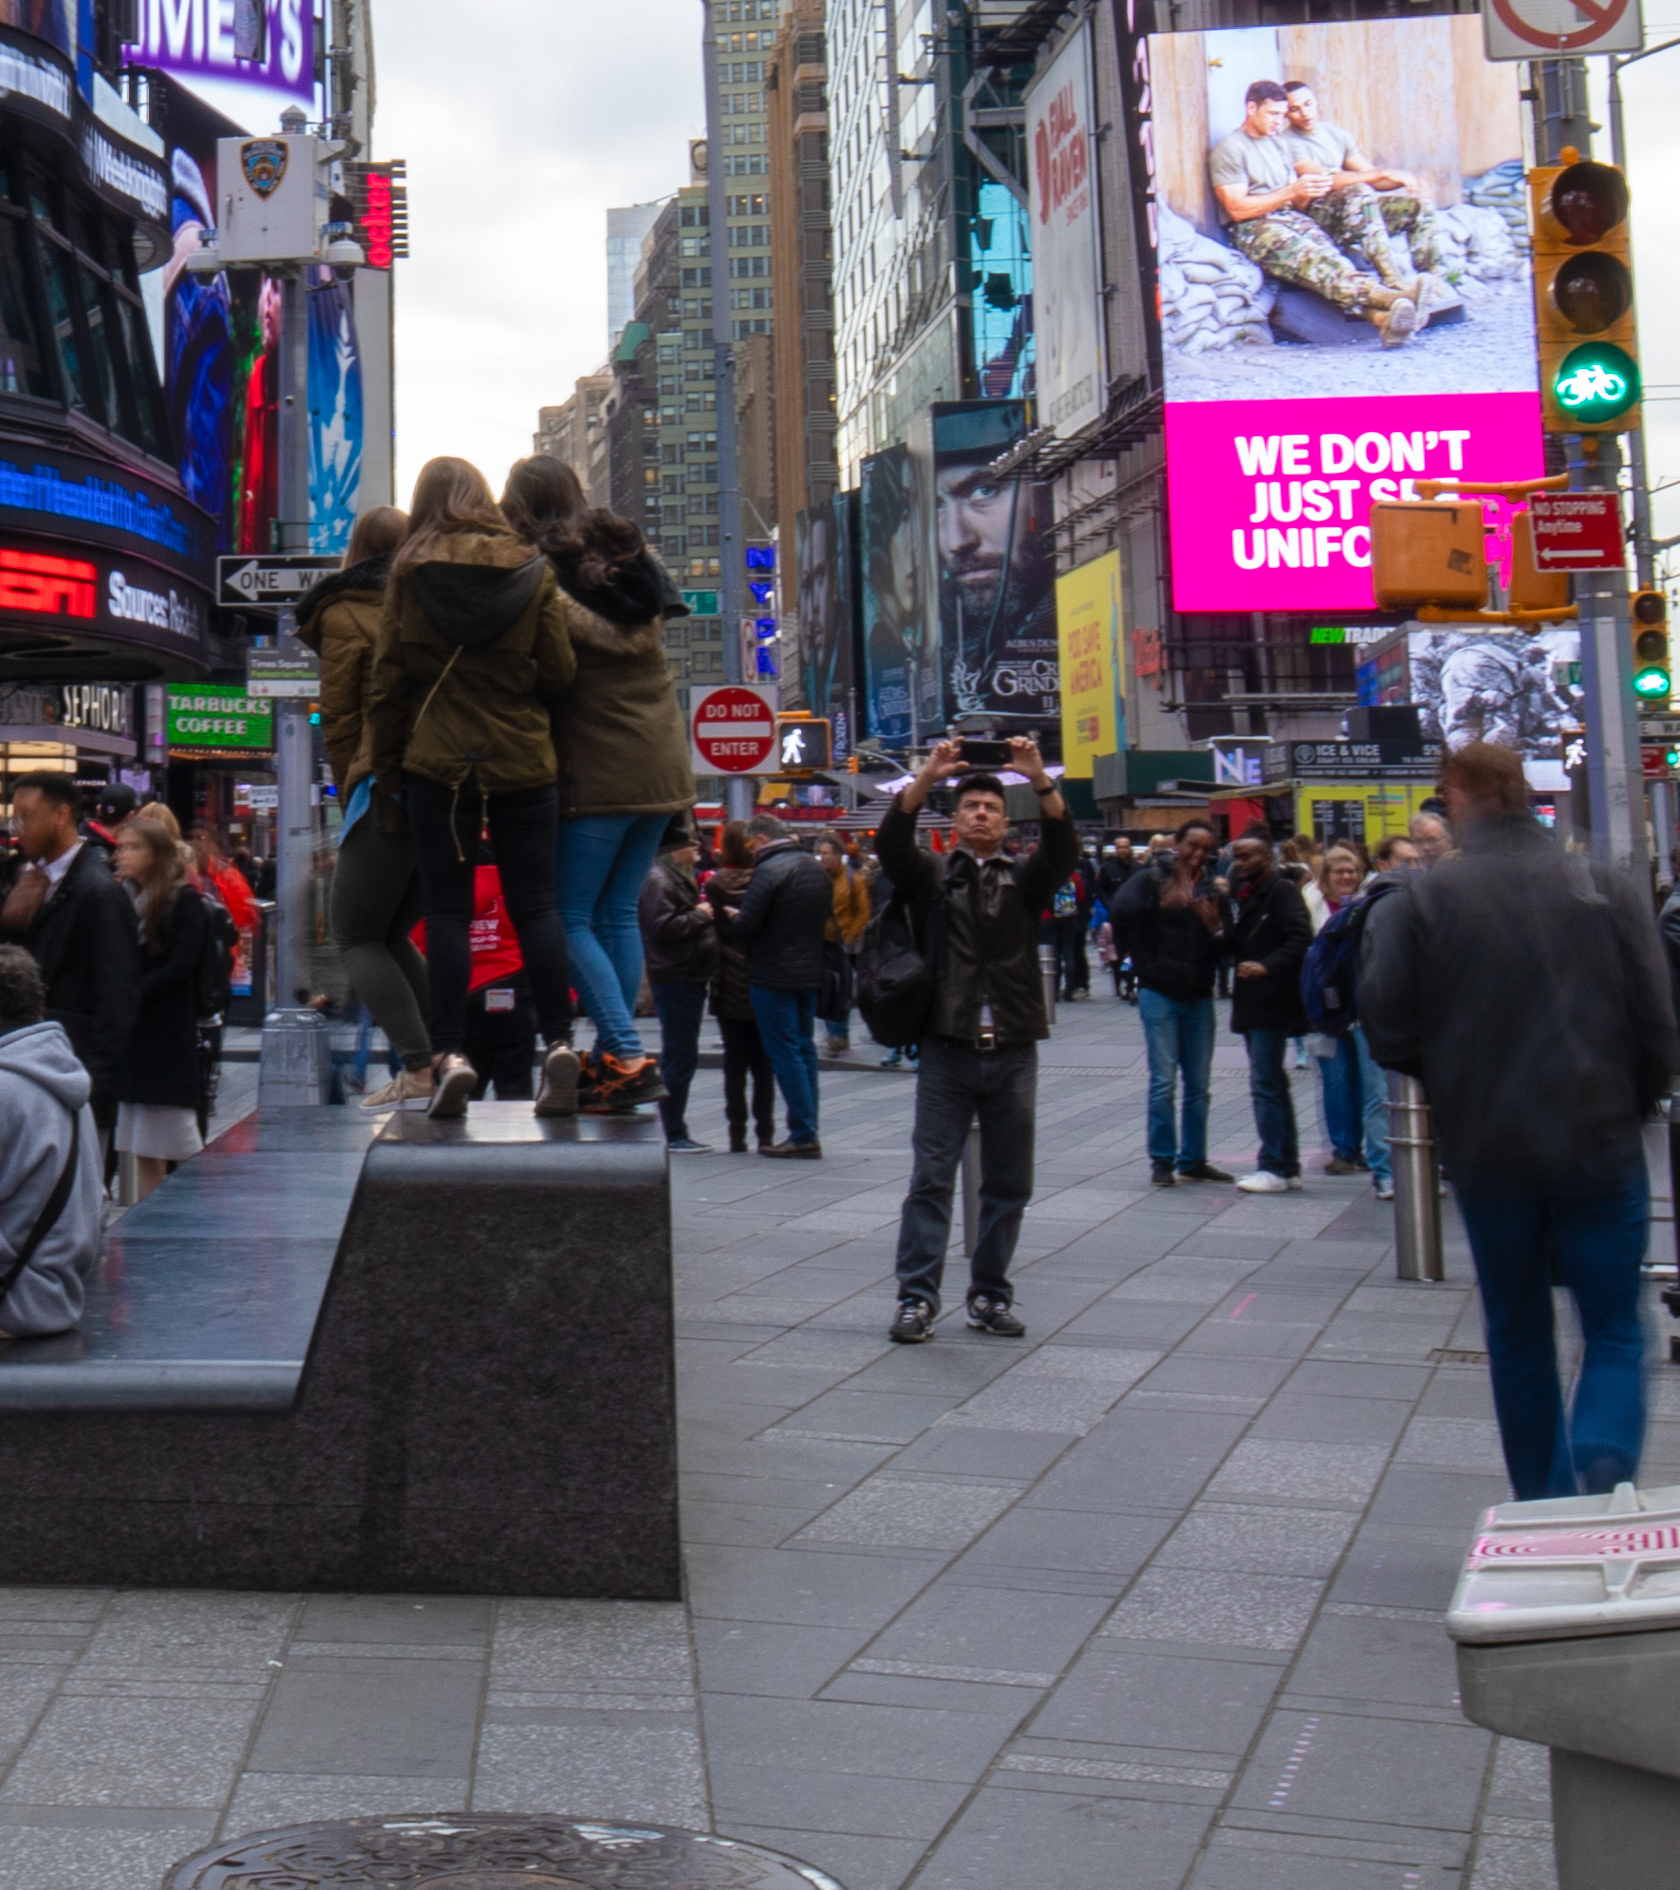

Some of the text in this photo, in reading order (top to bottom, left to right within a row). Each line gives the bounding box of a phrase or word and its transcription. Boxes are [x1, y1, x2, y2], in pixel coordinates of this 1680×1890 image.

[1234, 429, 1471, 476] WE DON'T
[1249, 478, 1361, 523] JUST
[240, 571, 279, 590] ONE
[62, 684, 127, 733] SEPHOR
[167, 694, 271, 716] TARBUCKS
[705, 703, 762, 718] DO NOT
[175, 716, 249, 736] COFFEE
[711, 741, 760, 757] ENTER
[1315, 744, 1381, 757] ICE & VICE
